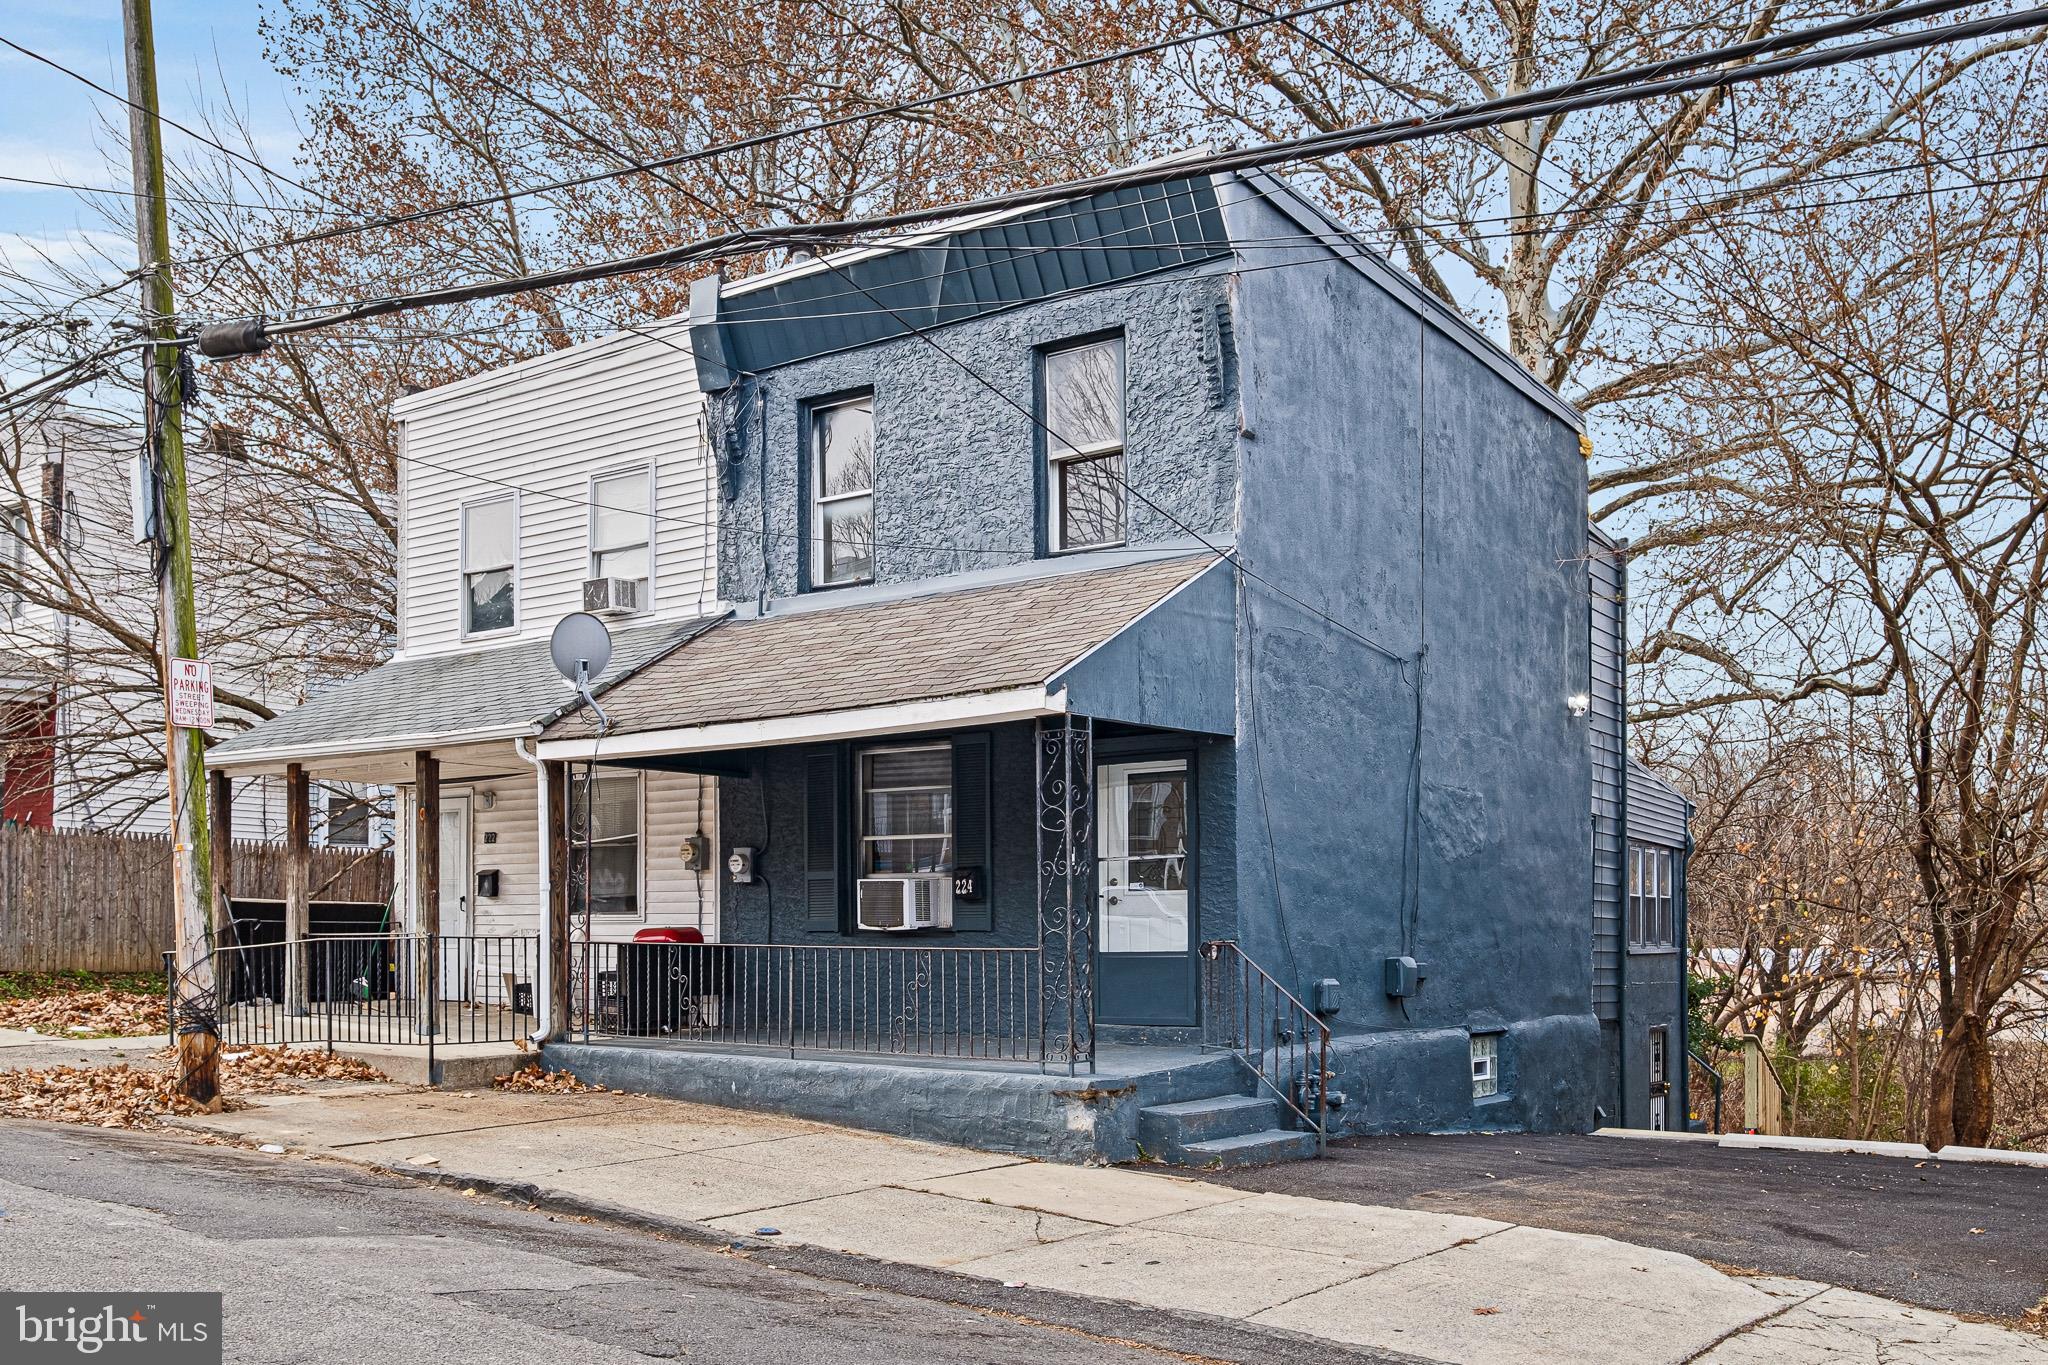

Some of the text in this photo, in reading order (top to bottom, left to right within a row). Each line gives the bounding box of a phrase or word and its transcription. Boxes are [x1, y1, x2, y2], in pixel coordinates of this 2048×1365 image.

[185, 664, 197, 677] NO
[173, 678, 209, 693] PARKING
[179, 693, 205, 701] STREET
[175, 700, 209, 709] SWEEPING
[175, 708, 209, 716] WEDNESDAY
[955, 879, 973, 895] 224
